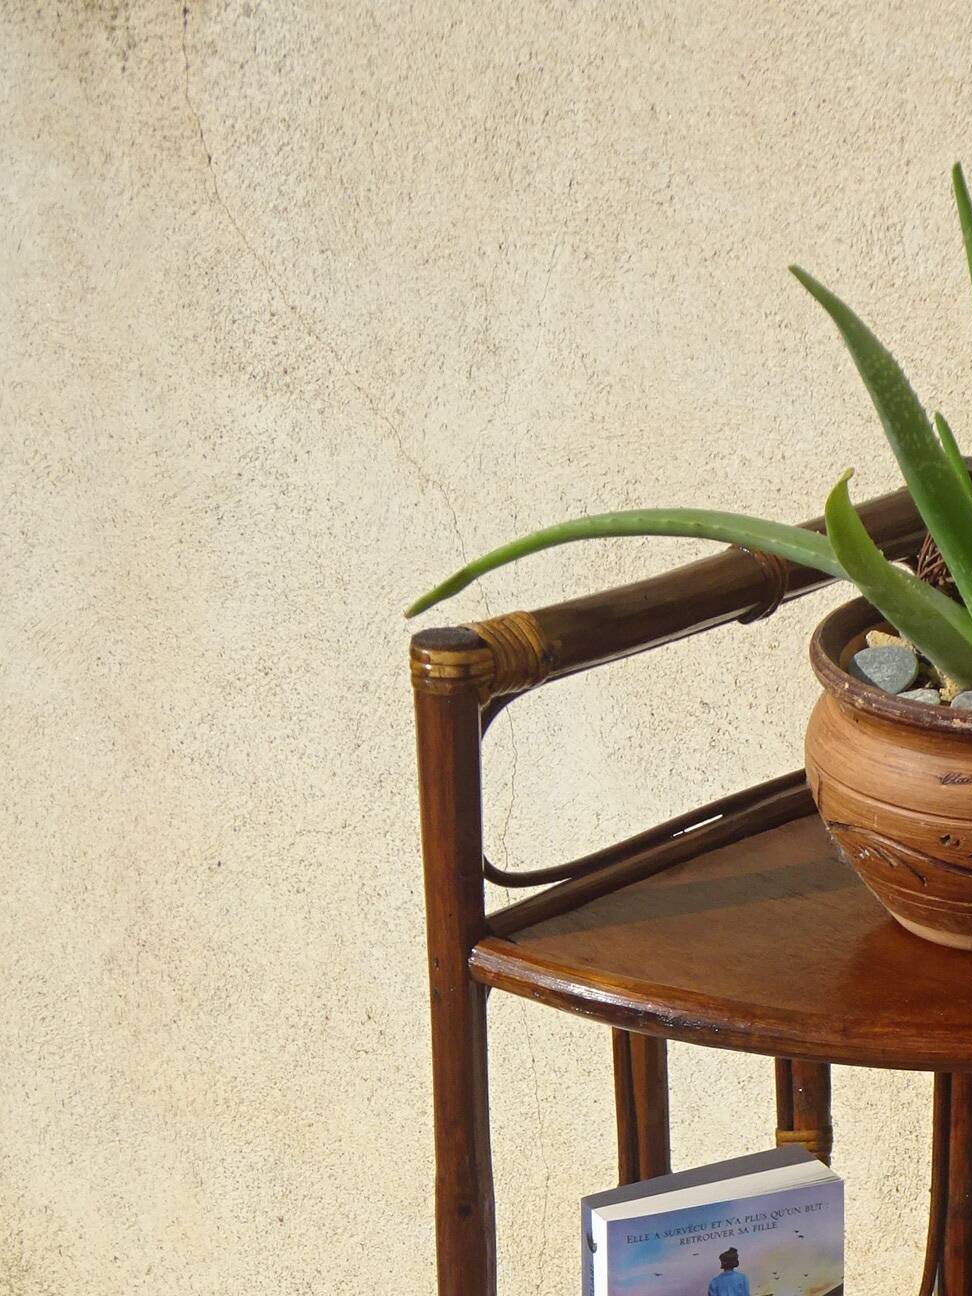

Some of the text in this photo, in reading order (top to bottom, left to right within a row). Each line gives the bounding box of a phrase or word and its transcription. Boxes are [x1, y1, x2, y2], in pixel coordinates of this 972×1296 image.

[711, 1220, 722, 1230] ET
[744, 1211, 768, 1223] PLUS
[680, 1221, 778, 1246] RETROUVER SA FILLE
